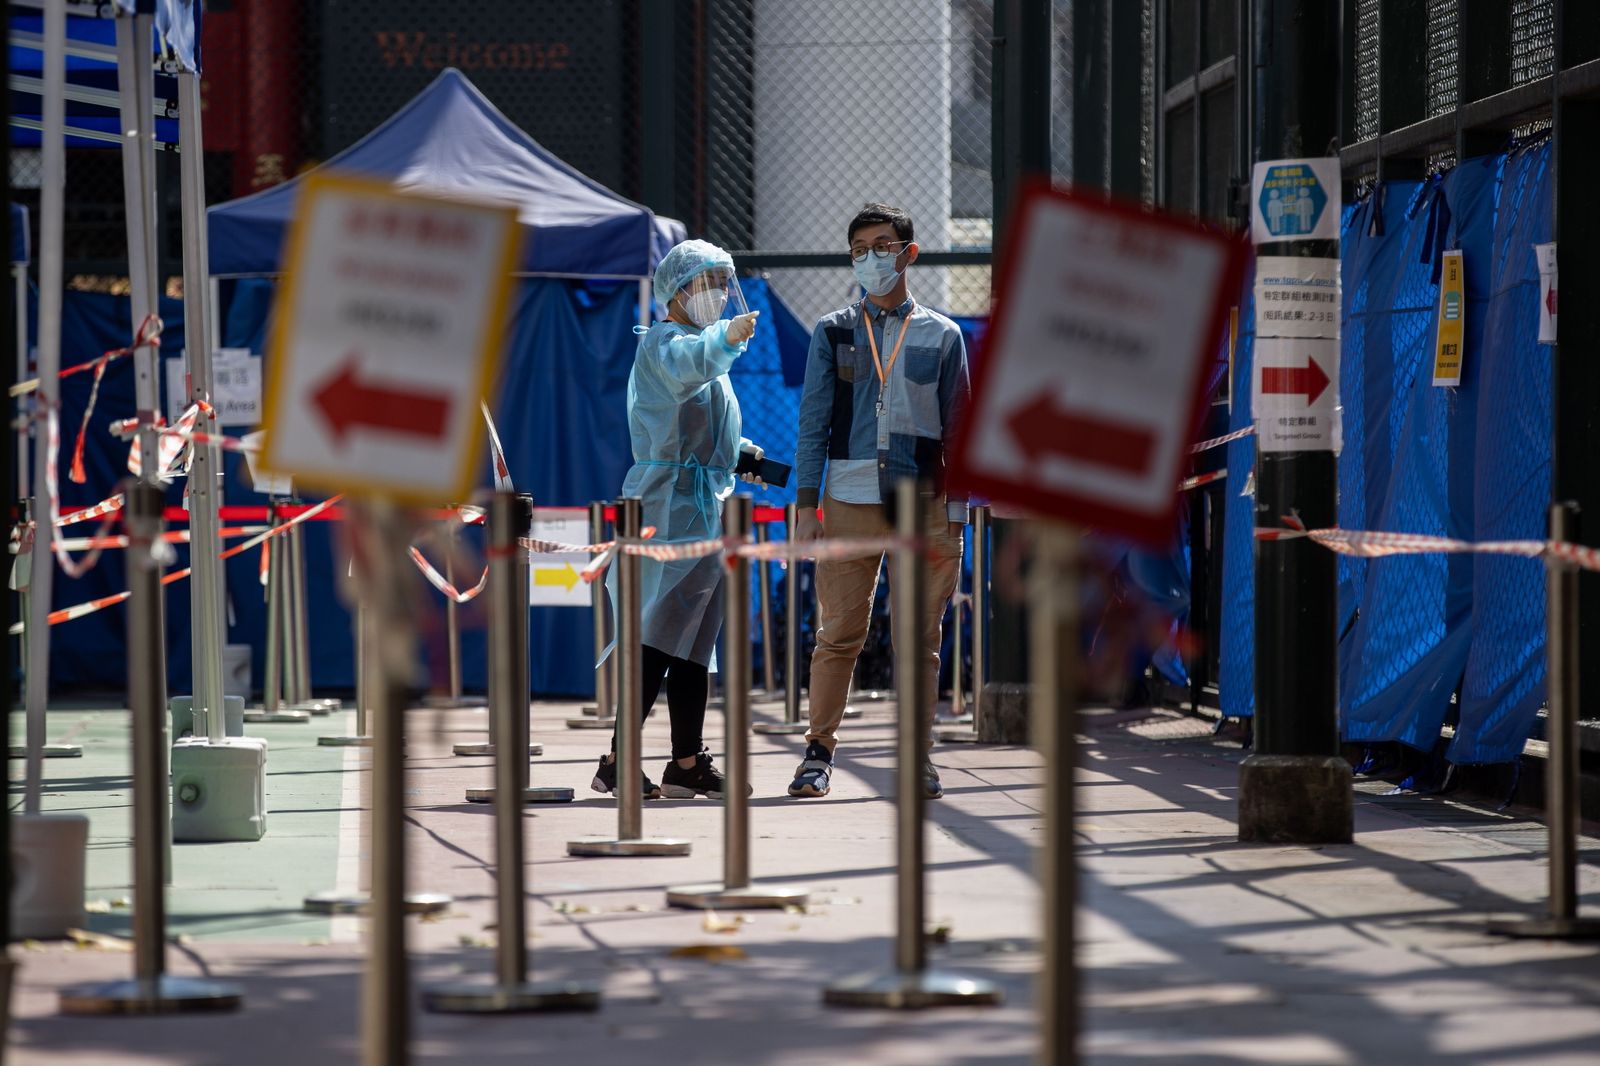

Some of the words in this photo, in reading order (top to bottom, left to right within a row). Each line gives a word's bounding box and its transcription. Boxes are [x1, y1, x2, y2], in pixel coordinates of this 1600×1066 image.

[374, 31, 571, 69] Welcome
[226, 400, 256, 411] Area
[1279, 416, 1317, 426] 特定群組
[1274, 433, 1301, 441] Targeted
[1303, 433, 1322, 441] Group
